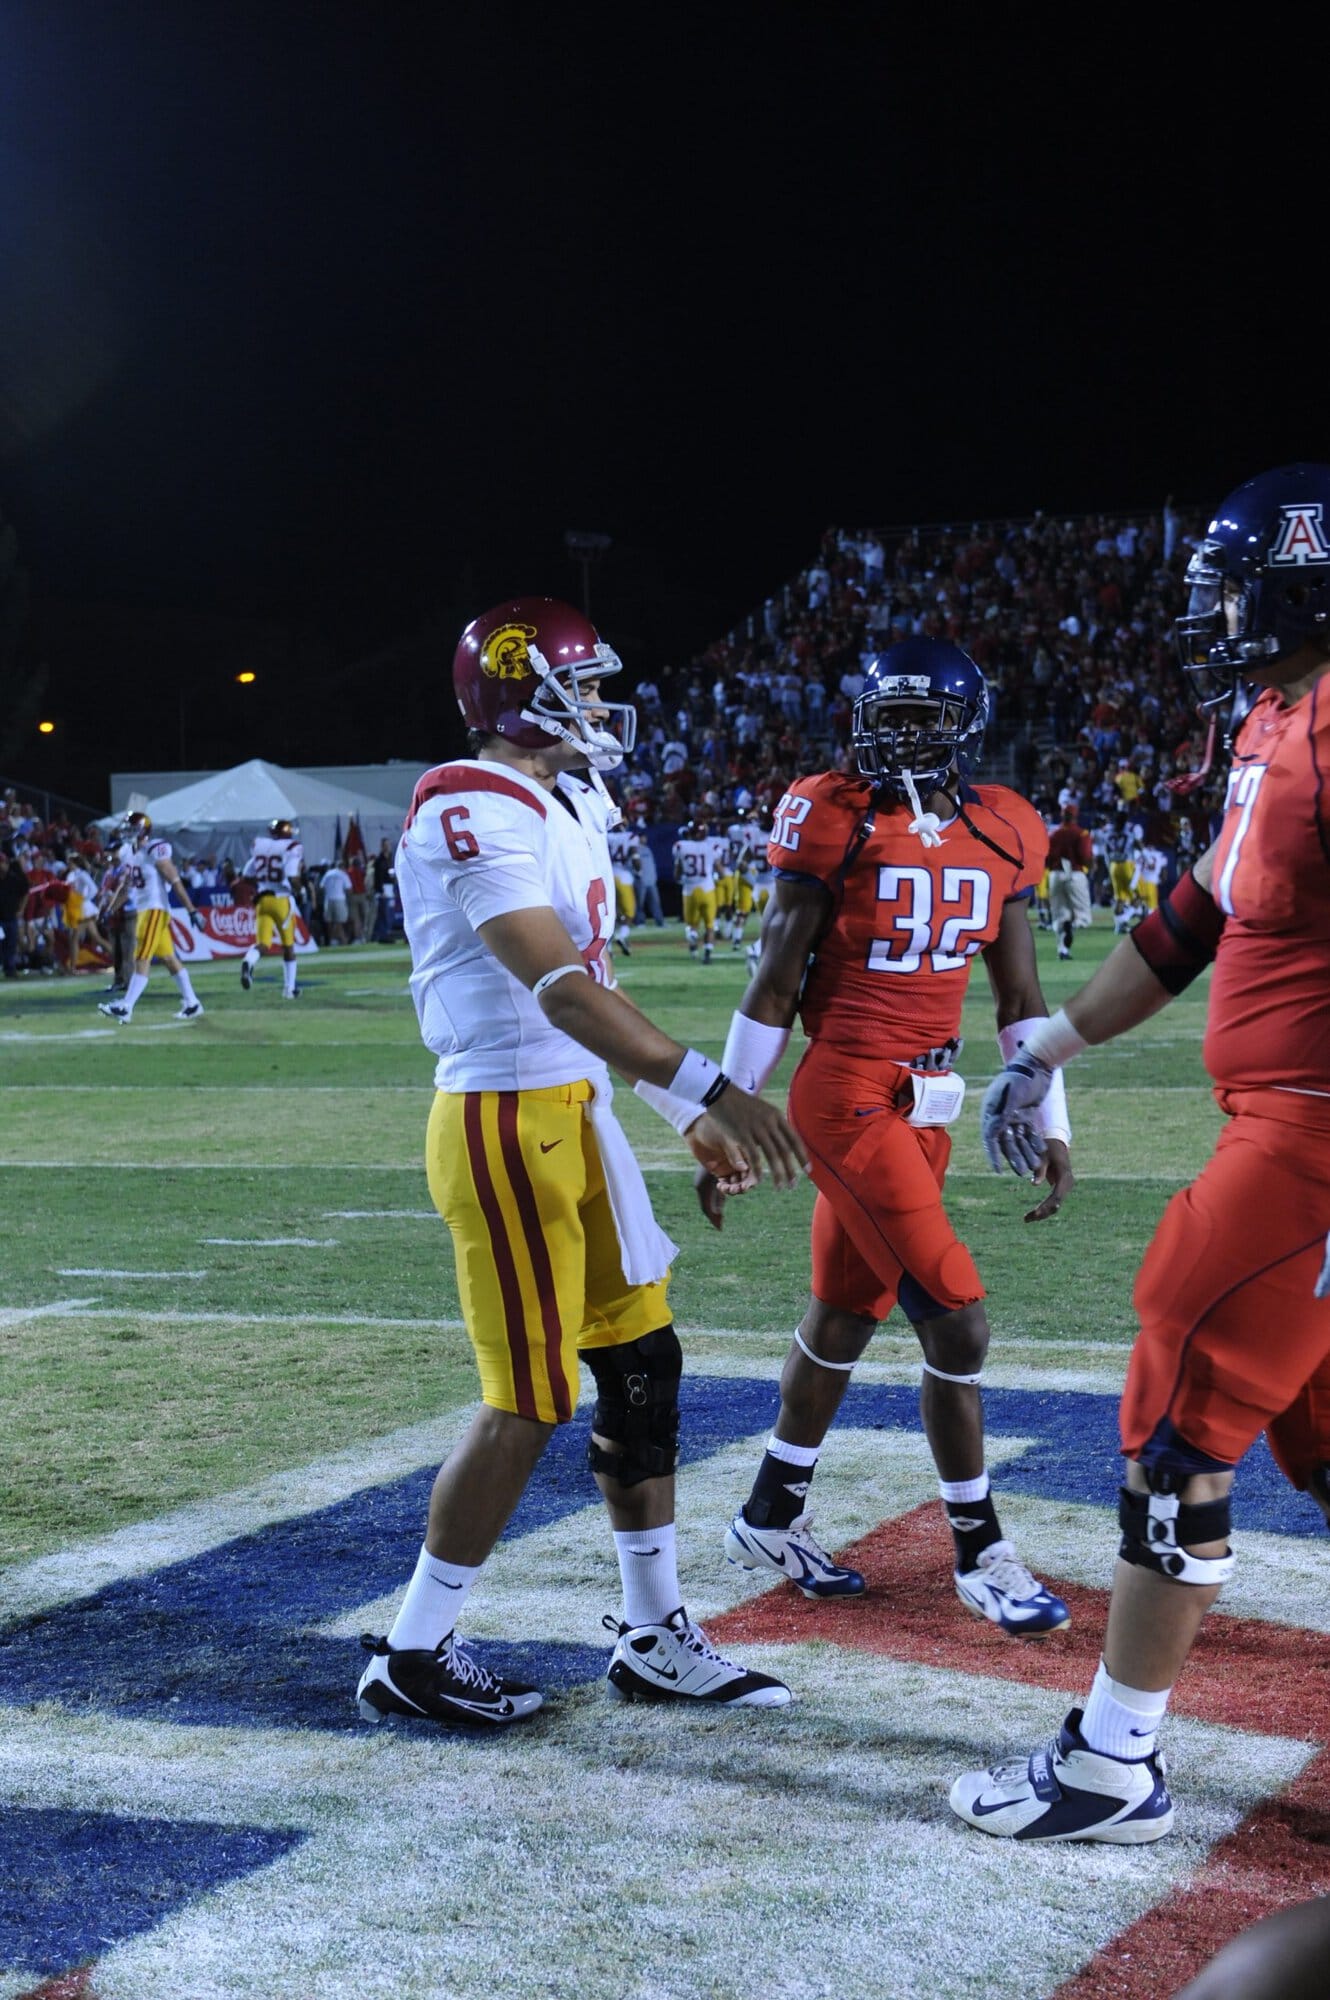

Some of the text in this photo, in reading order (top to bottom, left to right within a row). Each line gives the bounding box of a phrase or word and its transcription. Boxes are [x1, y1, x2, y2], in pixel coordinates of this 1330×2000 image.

[1268, 504, 1330, 567] A
[440, 805, 479, 861] 6
[255, 854, 284, 882] 26
[684, 854, 708, 878] 31
[865, 864, 992, 975] 32
